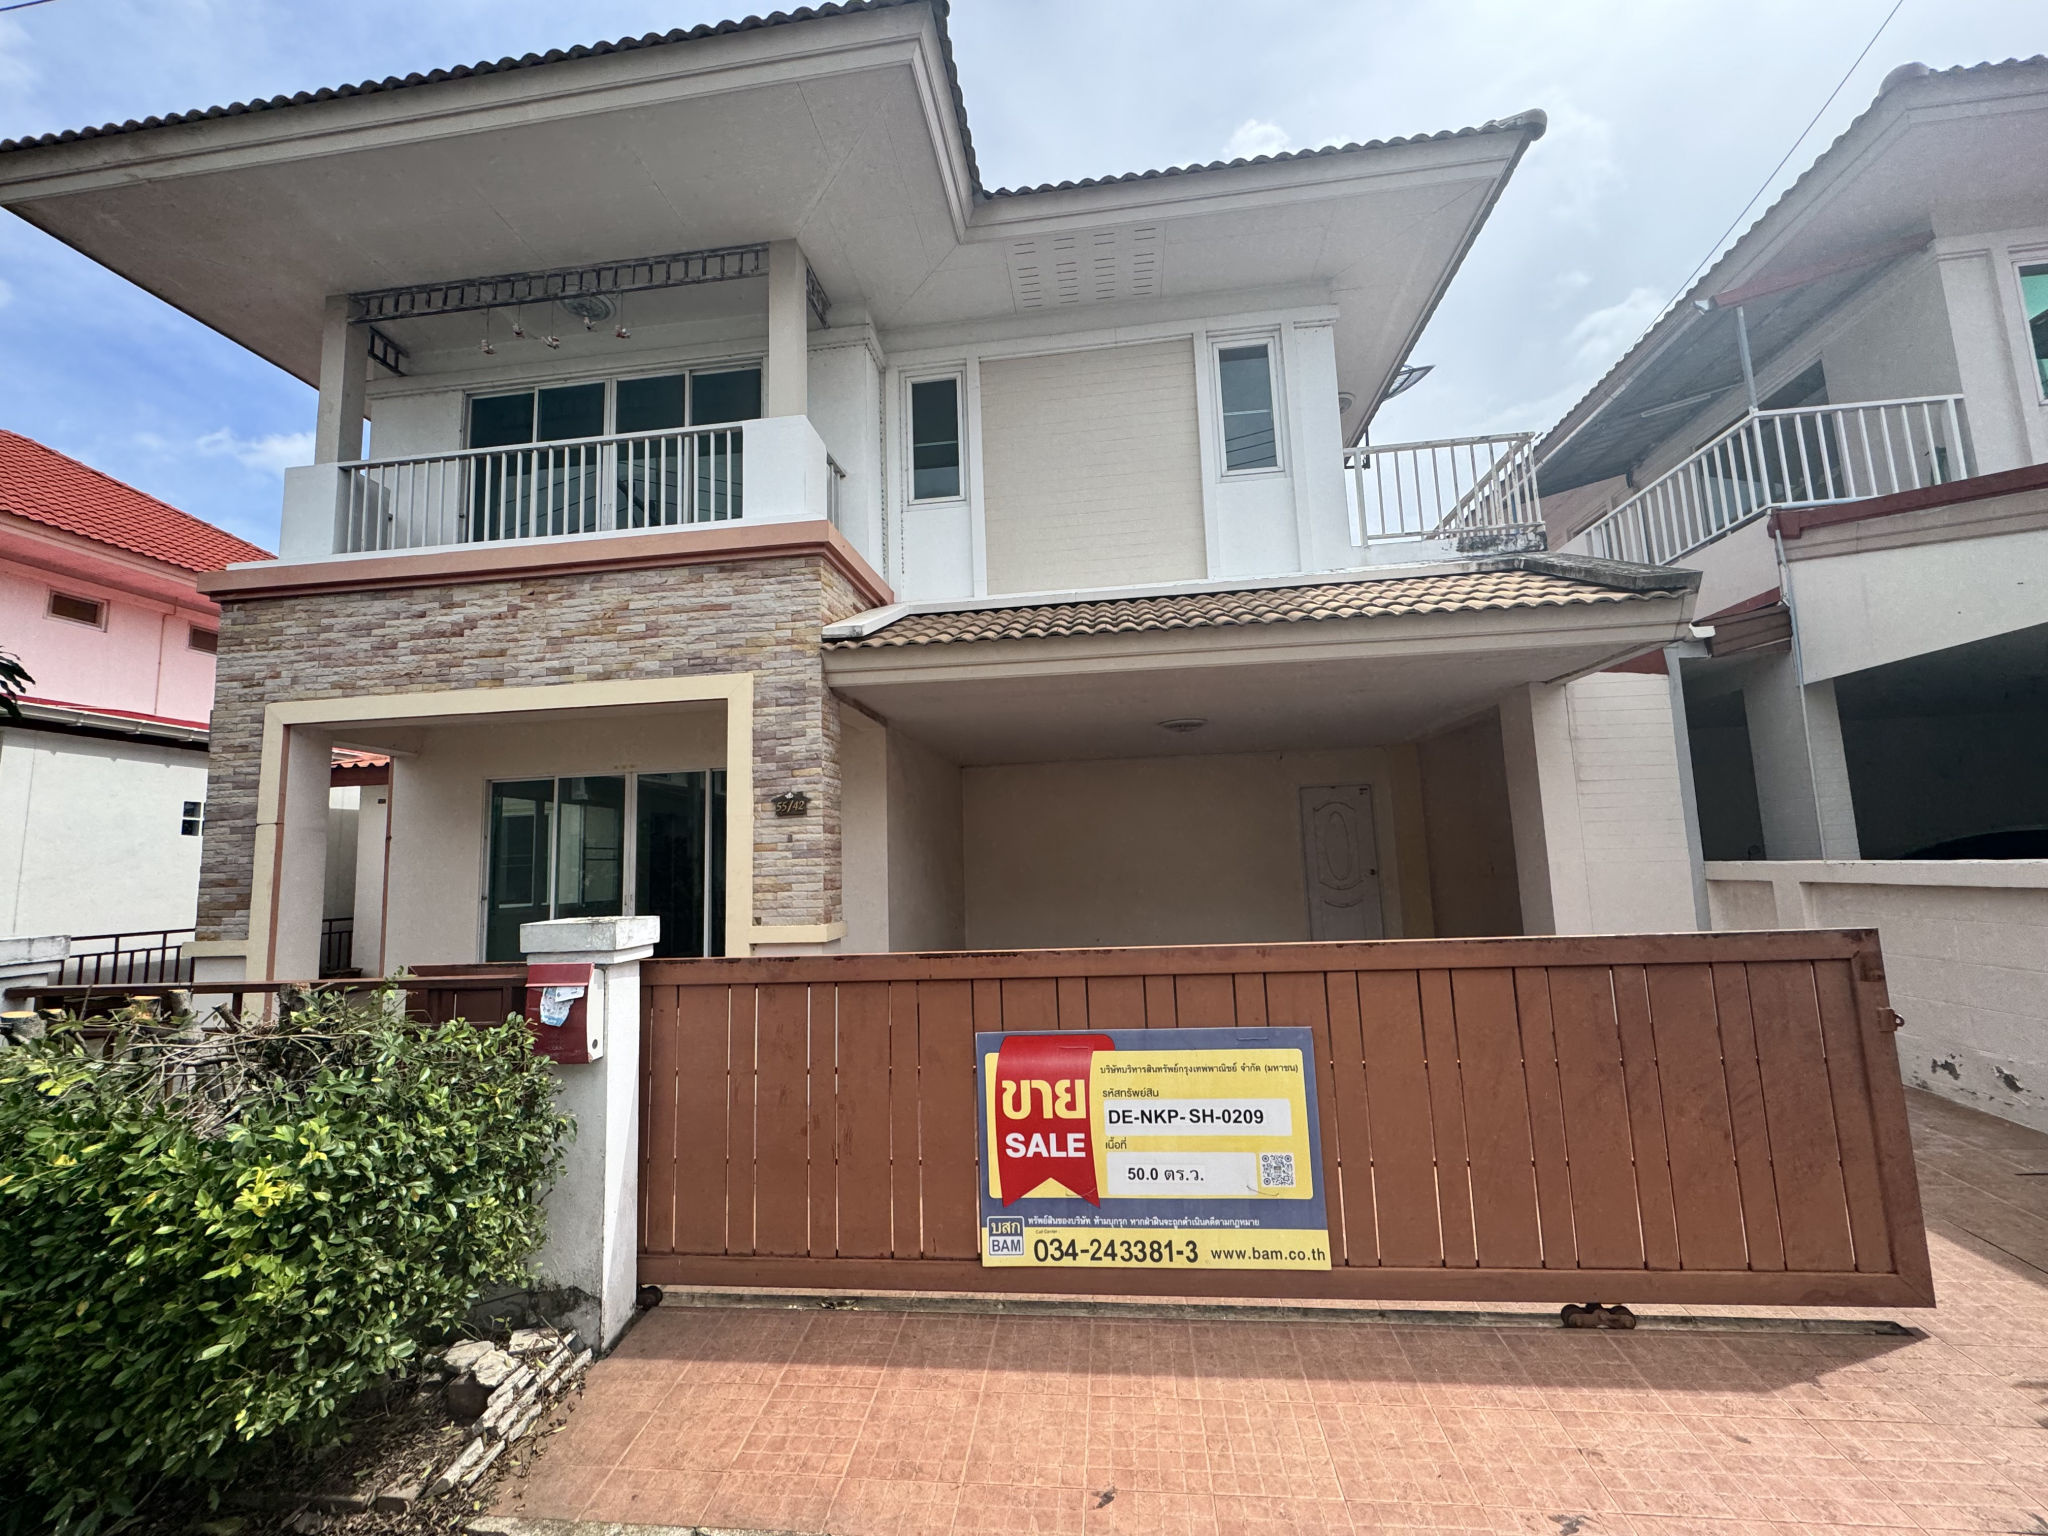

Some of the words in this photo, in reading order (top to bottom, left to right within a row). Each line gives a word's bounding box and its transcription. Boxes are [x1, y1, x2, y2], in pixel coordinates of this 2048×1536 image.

[776, 801, 805, 813] 55/42
[1240, 1063, 1261, 1073] จำกัด
[1264, 1064, 1299, 1074] (มหาชน)
[1001, 1079, 1086, 1120] ขาย
[1102, 1087, 1159, 1098] รหัสทรัพย์สิน
[1108, 1109, 1264, 1124] DE-NKP-SH-0209
[1005, 1132, 1086, 1158] SALE
[1105, 1137, 1127, 1150] เนื้อที่
[1127, 1167, 1159, 1181] 50.0
[1164, 1169, 1204, 1182] ตร.ว.
[991, 1221, 1021, 1234] บสก
[1094, 1215, 1128, 1228] ห้ามบุกรุก
[992, 1239, 1021, 1253] BAM
[1033, 1238, 1199, 1263] 034-243381-3
[1211, 1247, 1326, 1261] www.bam.co.th
